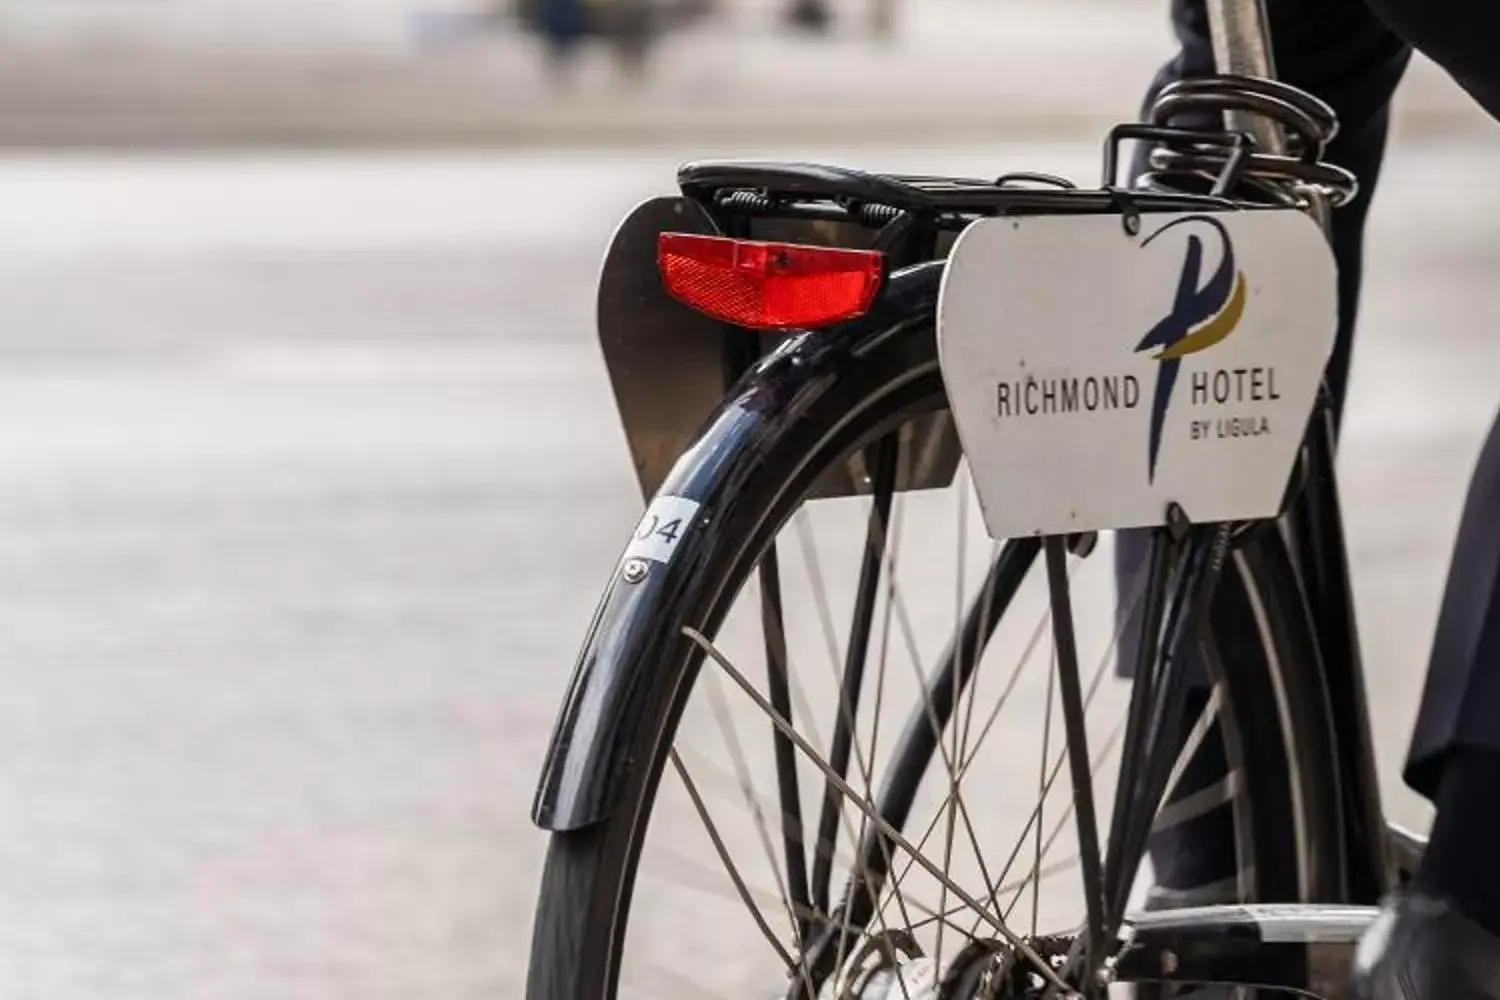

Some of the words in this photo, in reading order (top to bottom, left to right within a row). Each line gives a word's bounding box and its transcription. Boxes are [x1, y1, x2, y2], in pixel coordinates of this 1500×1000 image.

[998, 375, 1139, 416] RICHMOND
[1192, 367, 1280, 405] HOTEL
[1191, 420, 1211, 440] BY
[1217, 416, 1271, 438] LIGULA
